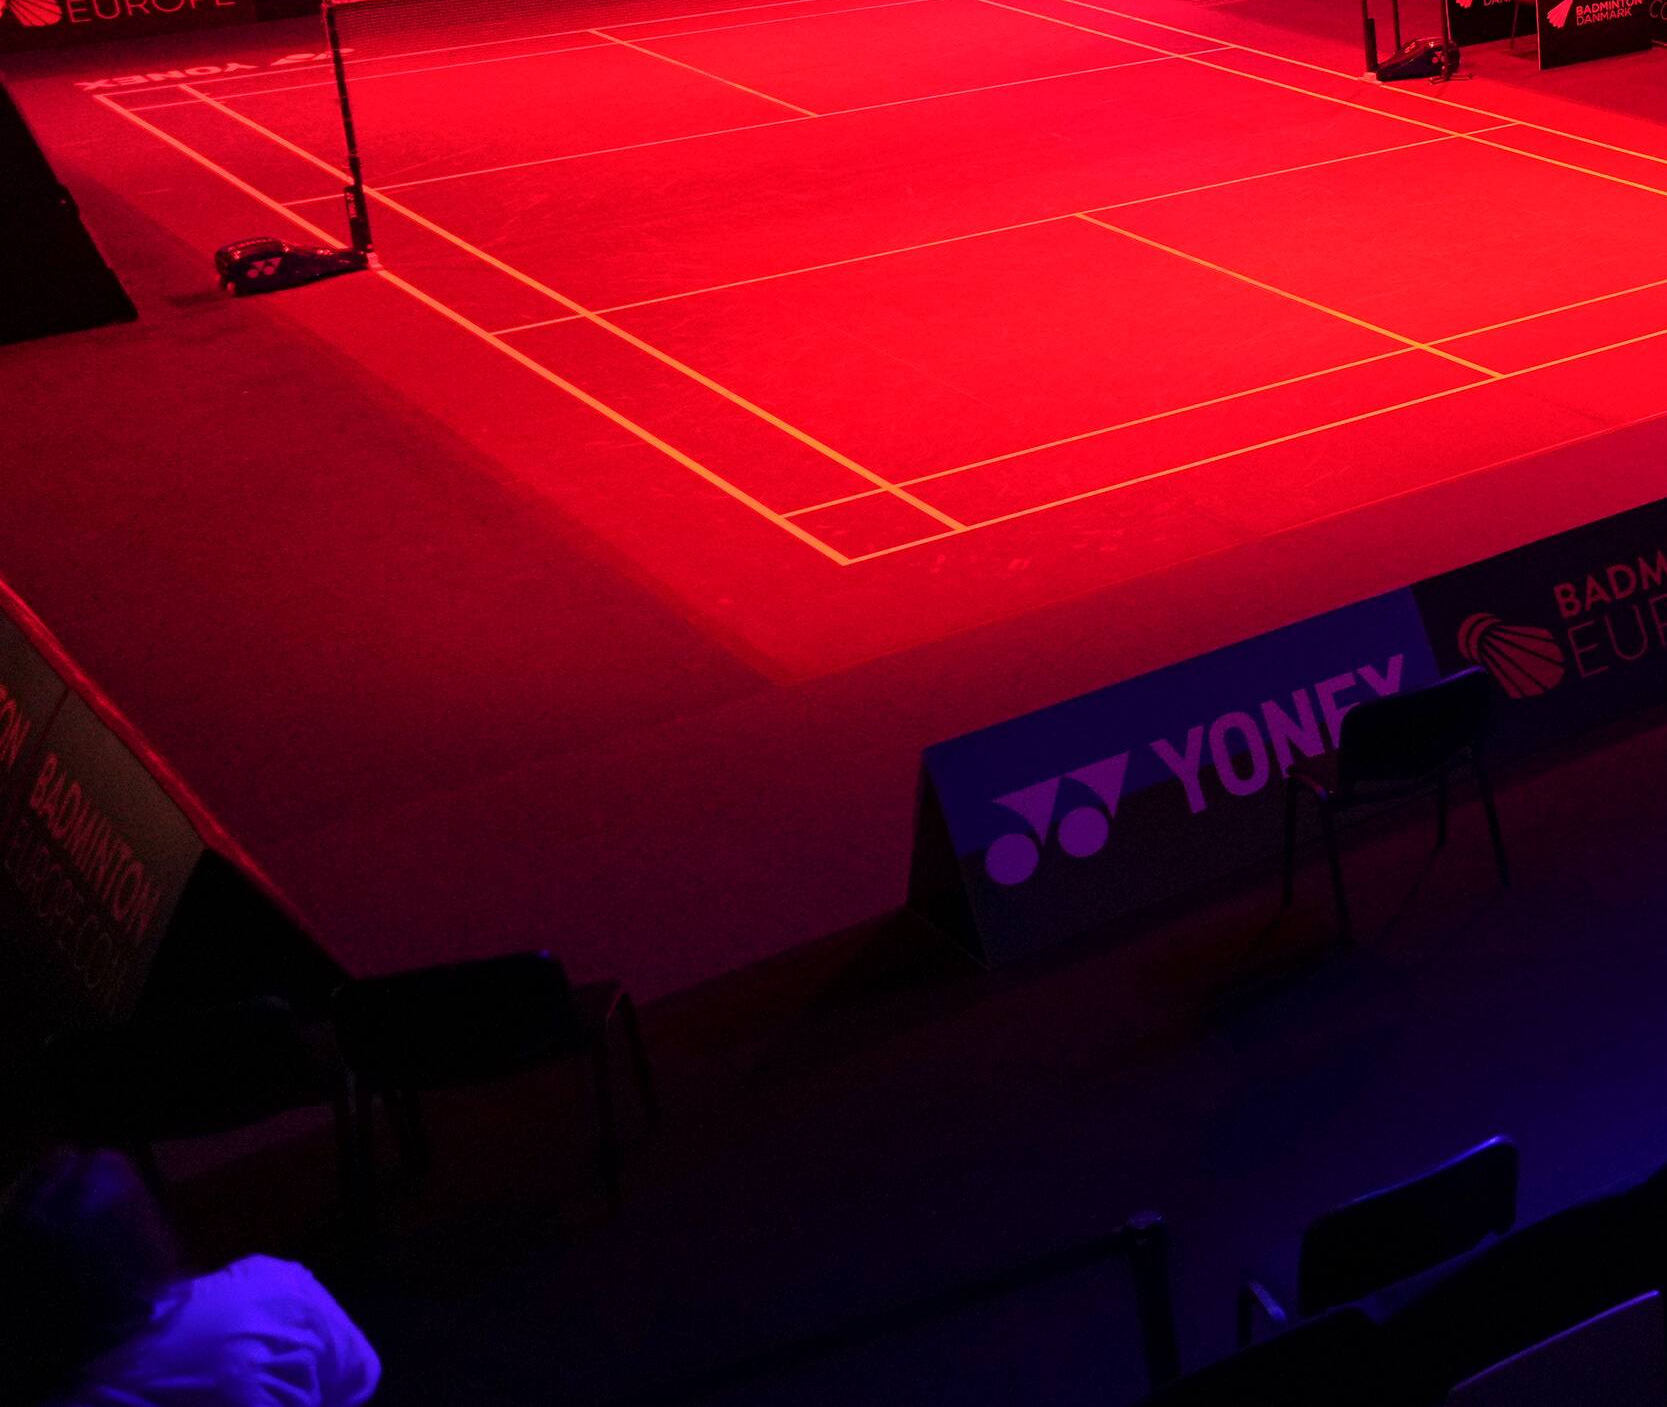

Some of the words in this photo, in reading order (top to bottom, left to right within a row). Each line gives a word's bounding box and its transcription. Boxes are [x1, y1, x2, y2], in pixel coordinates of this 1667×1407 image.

[1575, 7, 1633, 28] DANMARK
[74, 62, 258, 91] YONEX
[28, 749, 164, 944] BADMINTON
